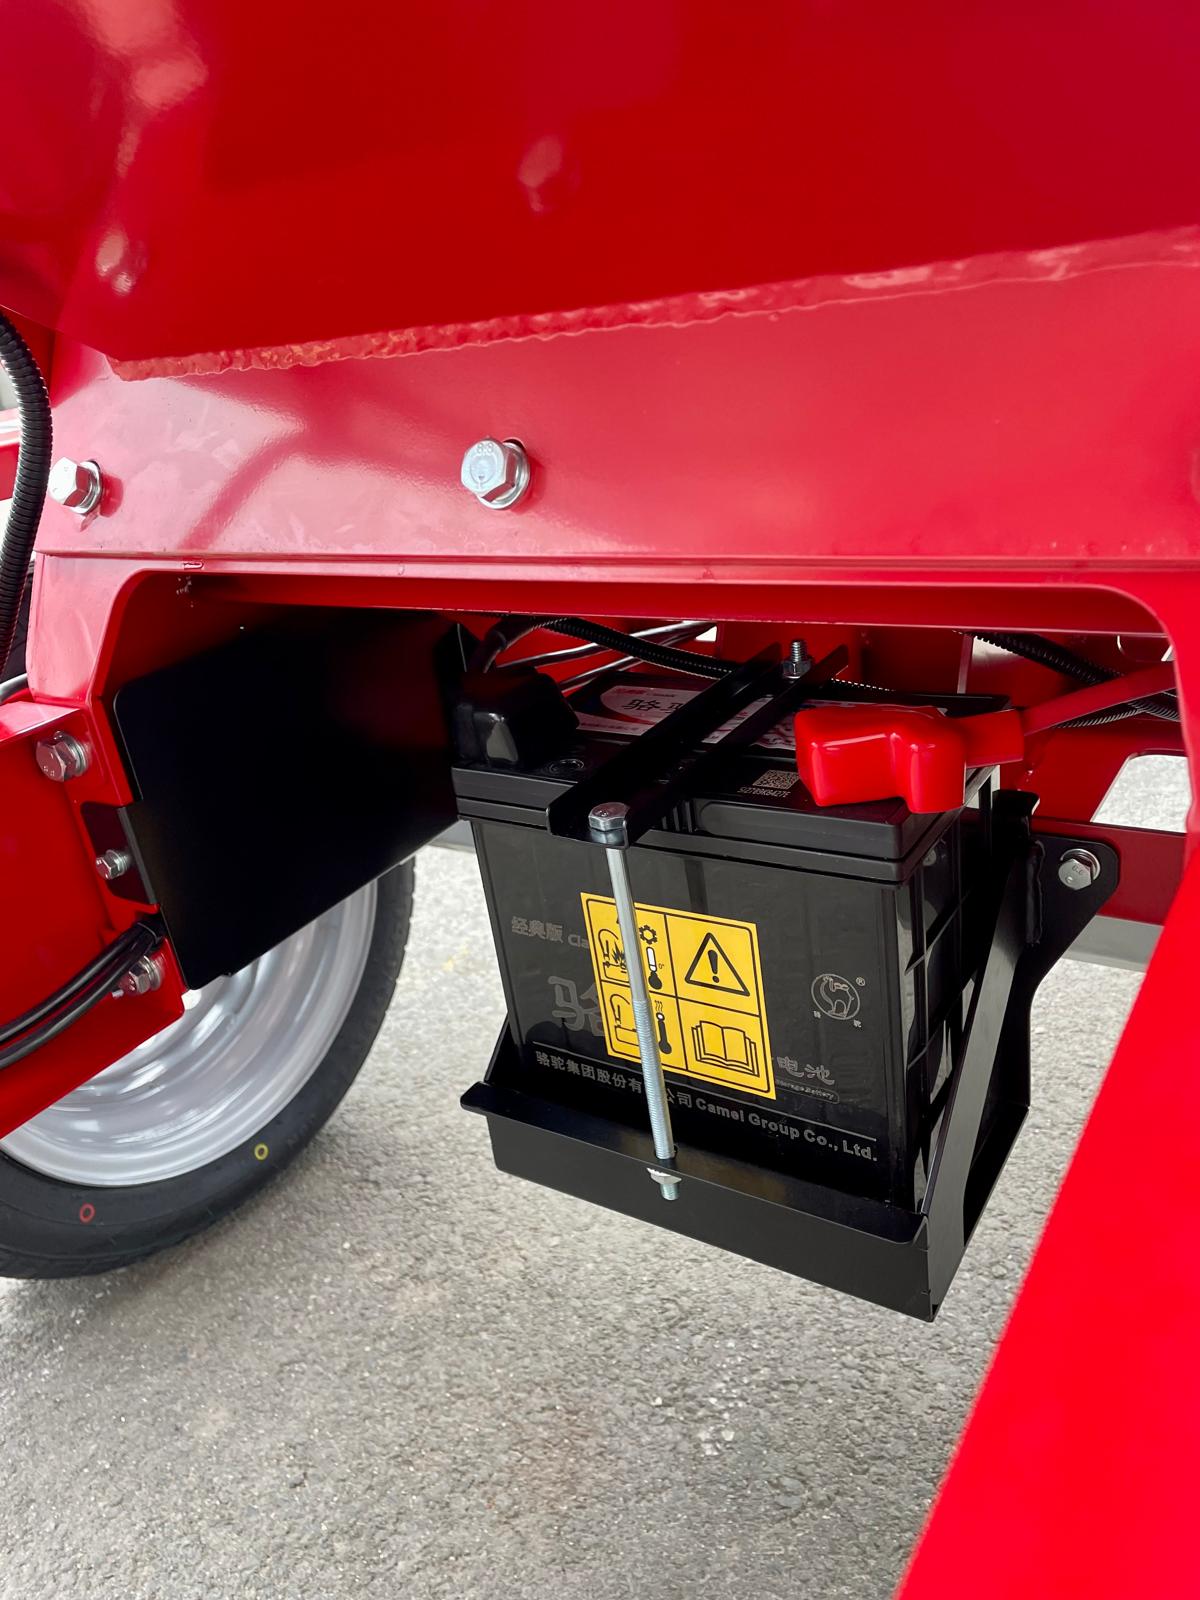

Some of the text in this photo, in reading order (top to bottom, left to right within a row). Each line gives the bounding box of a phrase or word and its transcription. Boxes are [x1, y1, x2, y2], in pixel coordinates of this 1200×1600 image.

[511, 915, 564, 943] 经典版
[696, 1098, 877, 1161] Camel Group Co., Ltd.
